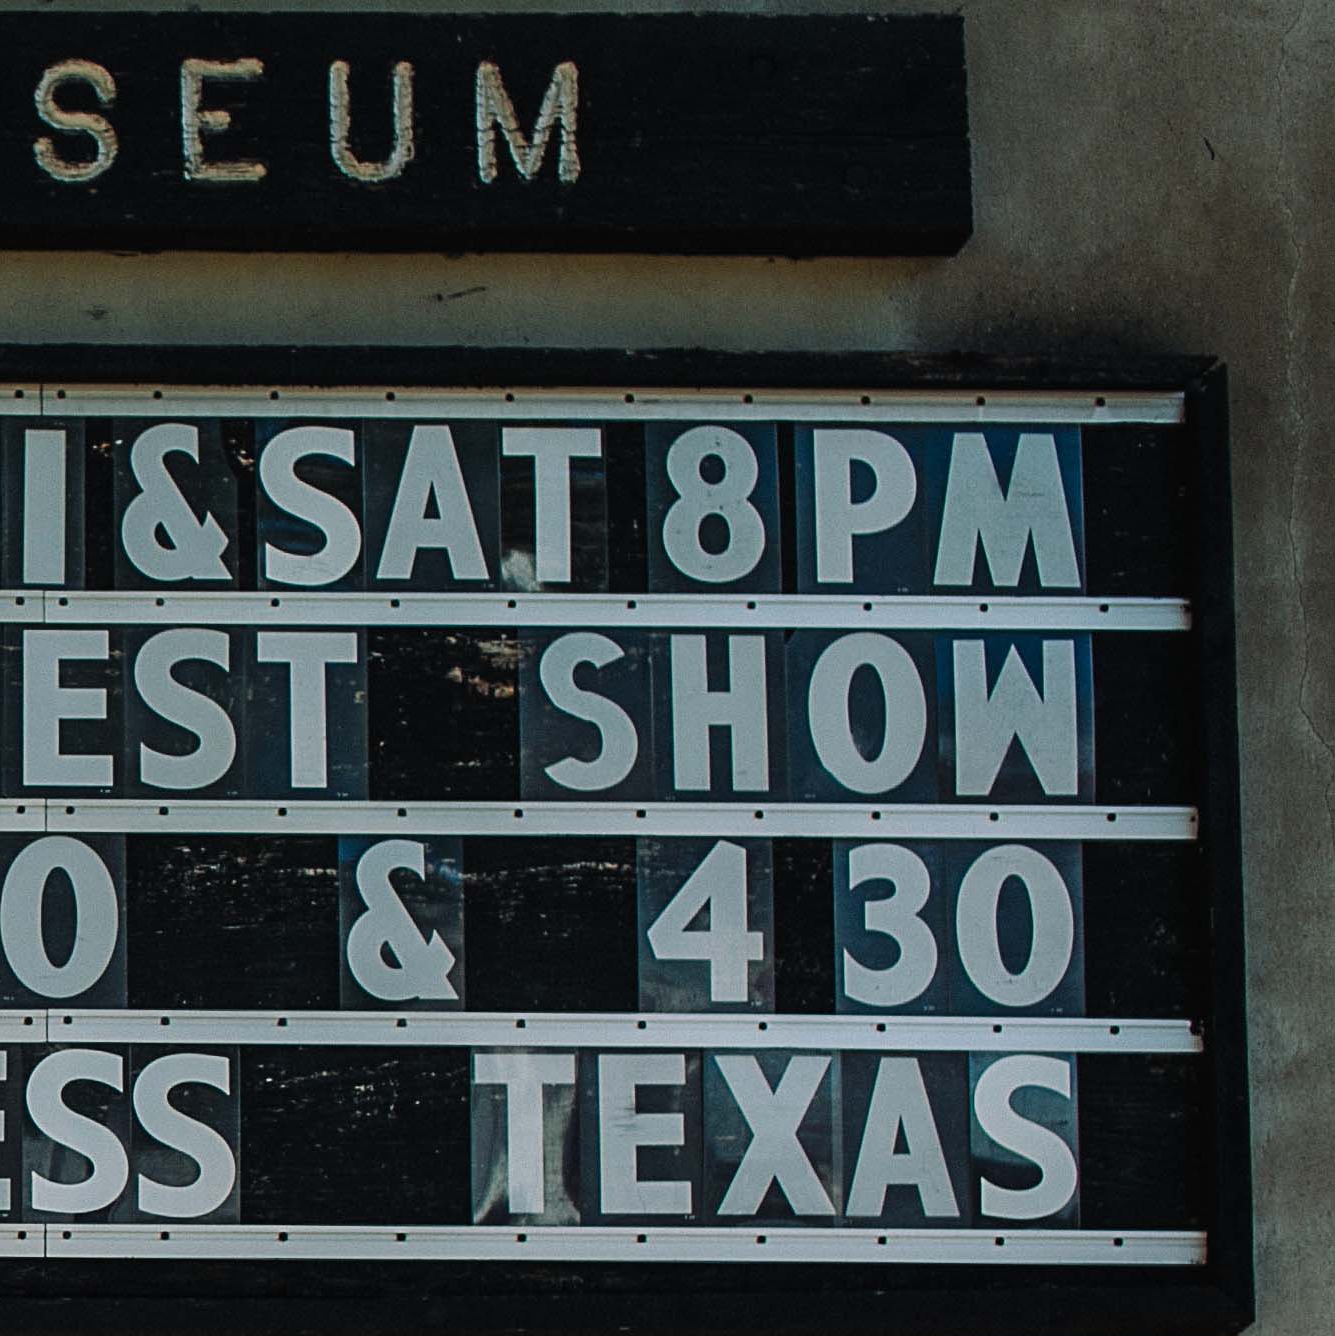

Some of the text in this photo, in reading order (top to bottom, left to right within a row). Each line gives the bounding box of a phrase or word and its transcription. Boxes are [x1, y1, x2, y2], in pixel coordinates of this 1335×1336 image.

[537, 632, 1079, 797] SHOW
[346, 838, 459, 1000] &
[471, 1053, 1080, 1220] TEXAS
